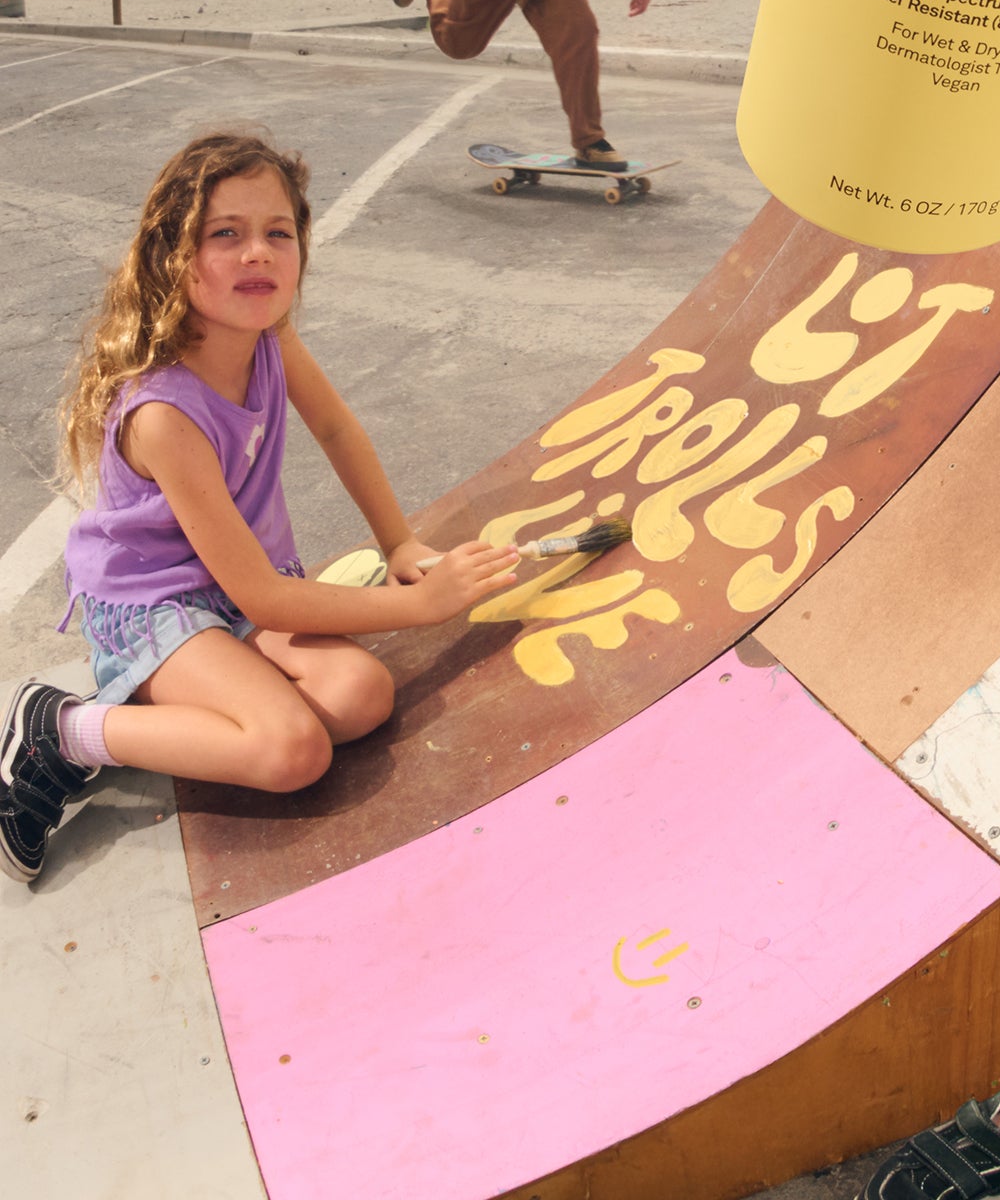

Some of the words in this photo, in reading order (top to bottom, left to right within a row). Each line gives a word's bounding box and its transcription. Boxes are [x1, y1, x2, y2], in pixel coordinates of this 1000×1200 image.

[876, 35, 991, 76] Dermatologist
[891, 21, 919, 41] For
[922, 31, 954, 51] Wet
[958, 40, 971, 54] &
[932, 72, 981, 93] Vegan
[830, 175, 862, 200] Net
[866, 189, 894, 209] Wt.
[900, 199, 912, 212] 6
[916, 201, 943, 216] OZ
[944, 203, 955, 216] /
[750, 253, 994, 417] LOT
[531, 348, 855, 613] TROLLS
